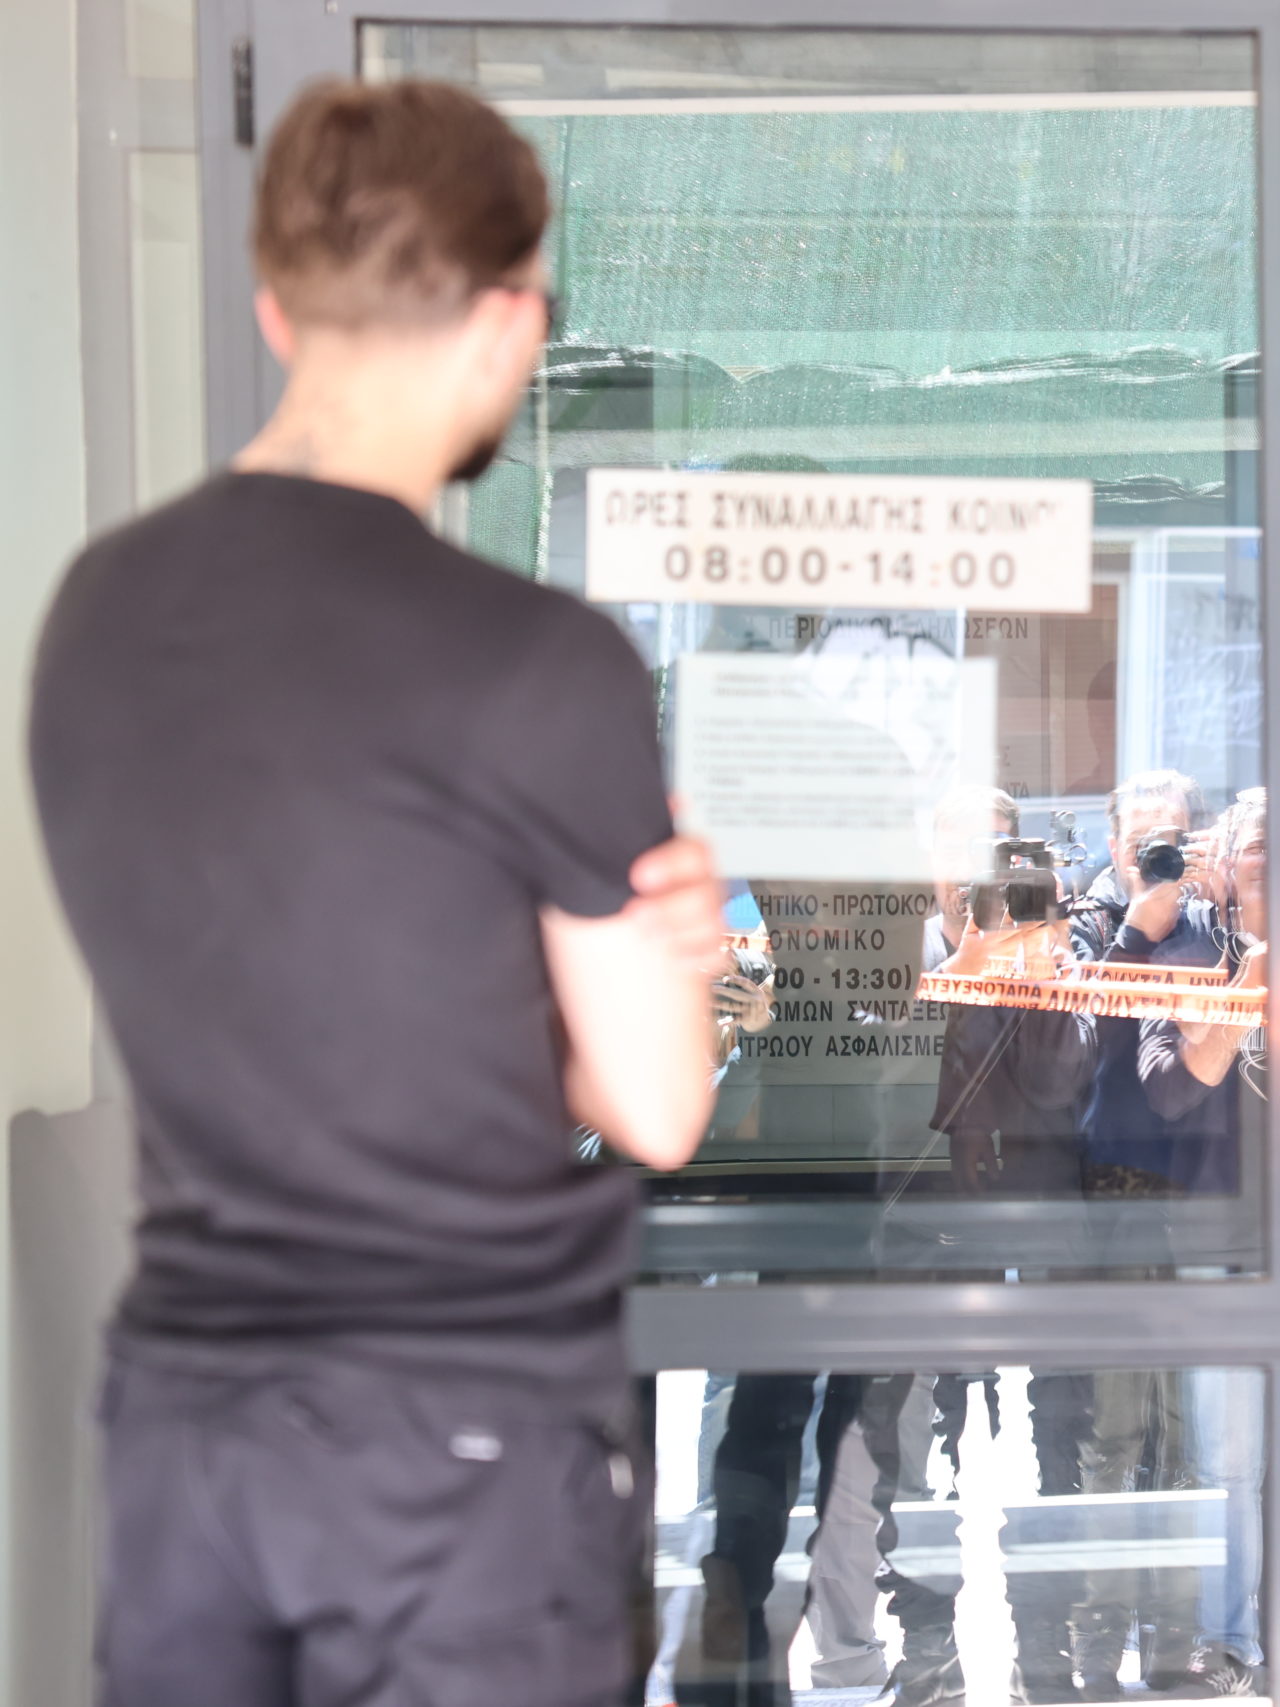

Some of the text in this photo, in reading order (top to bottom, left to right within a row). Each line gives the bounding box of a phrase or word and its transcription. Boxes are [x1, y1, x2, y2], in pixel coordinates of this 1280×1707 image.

[605, 490, 689, 527] ΩΡΕΣ
[712, 491, 925, 532] ΣΥΝΑΛΛΑΓΗΣ
[664, 544, 1016, 588] 08:00-14:00
[831, 965, 912, 991] 13:30)
[826, 1035, 944, 1057] ΑΣΦΑΛΙΣΜΕ
